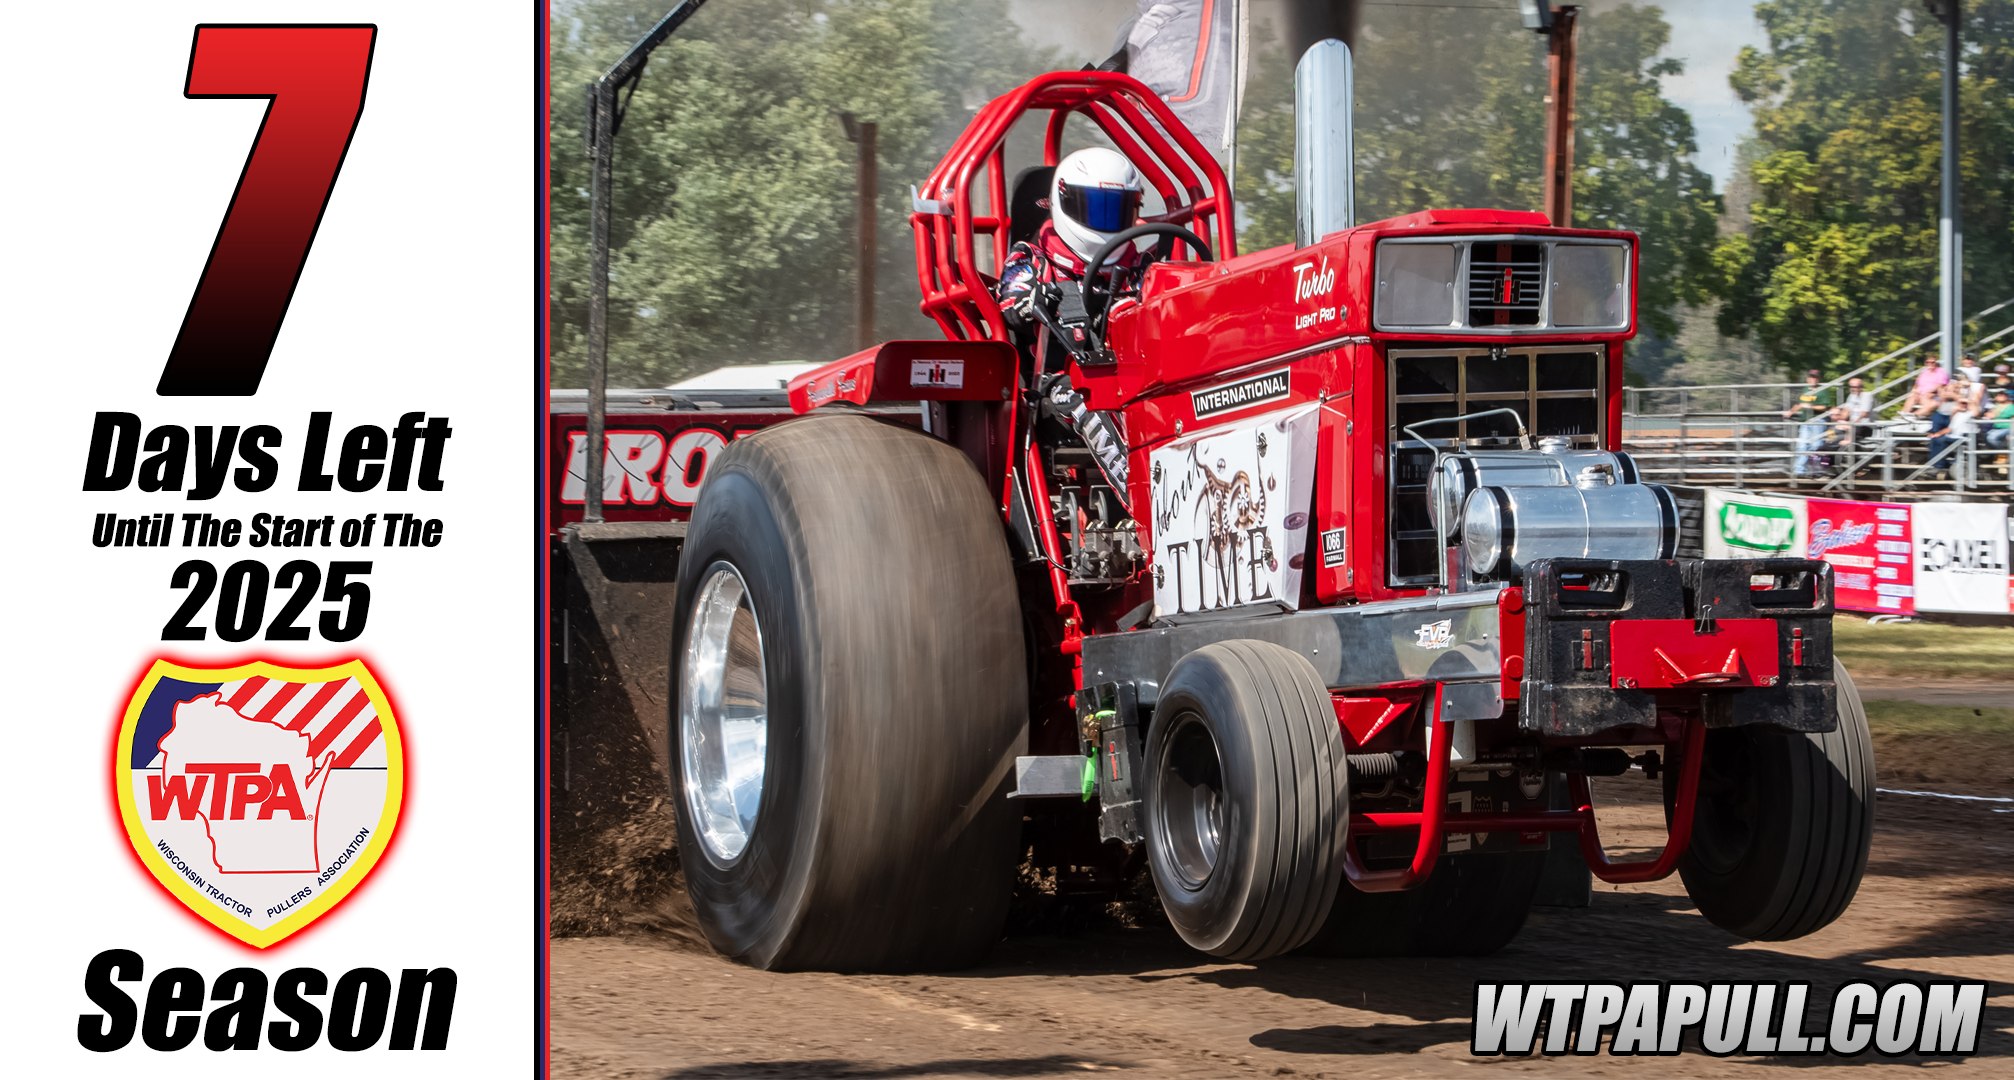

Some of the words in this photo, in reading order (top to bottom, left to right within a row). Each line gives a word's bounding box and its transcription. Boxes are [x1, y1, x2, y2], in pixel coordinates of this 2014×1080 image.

[1293, 255, 1334, 304] Turbo
[1196, 376, 1287, 412] INTERNATIONAL
[1325, 532, 1341, 551] 1066
[1167, 526, 1273, 613] TIME
